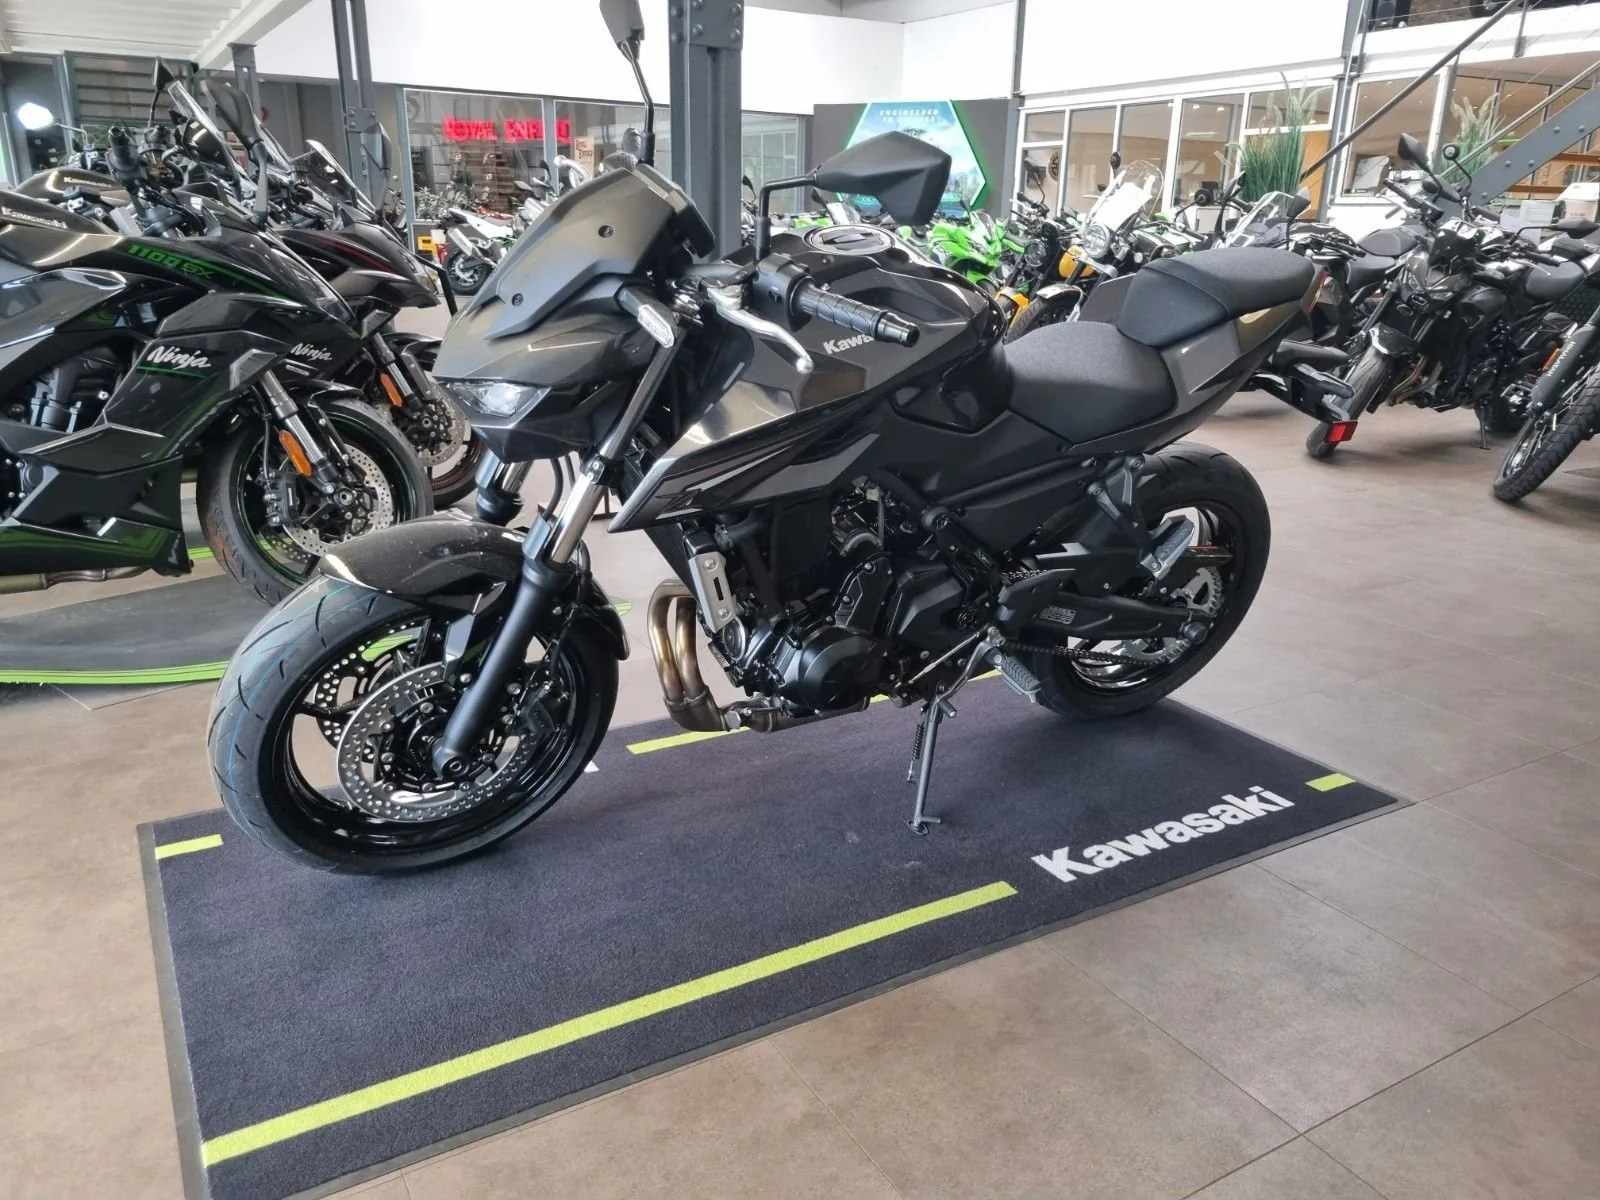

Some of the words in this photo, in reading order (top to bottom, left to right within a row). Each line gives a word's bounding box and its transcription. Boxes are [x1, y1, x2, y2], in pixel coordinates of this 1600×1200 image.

[443, 115, 497, 143] ROYAL
[504, 117, 571, 144] ENFID
[1, 206, 68, 229] Kawasaki
[128, 244, 181, 269] 1100
[290, 343, 333, 361] Ninja
[822, 333, 875, 355] Kawa
[147, 345, 211, 370] Ninja
[1030, 785, 1296, 883] Kawasaki
